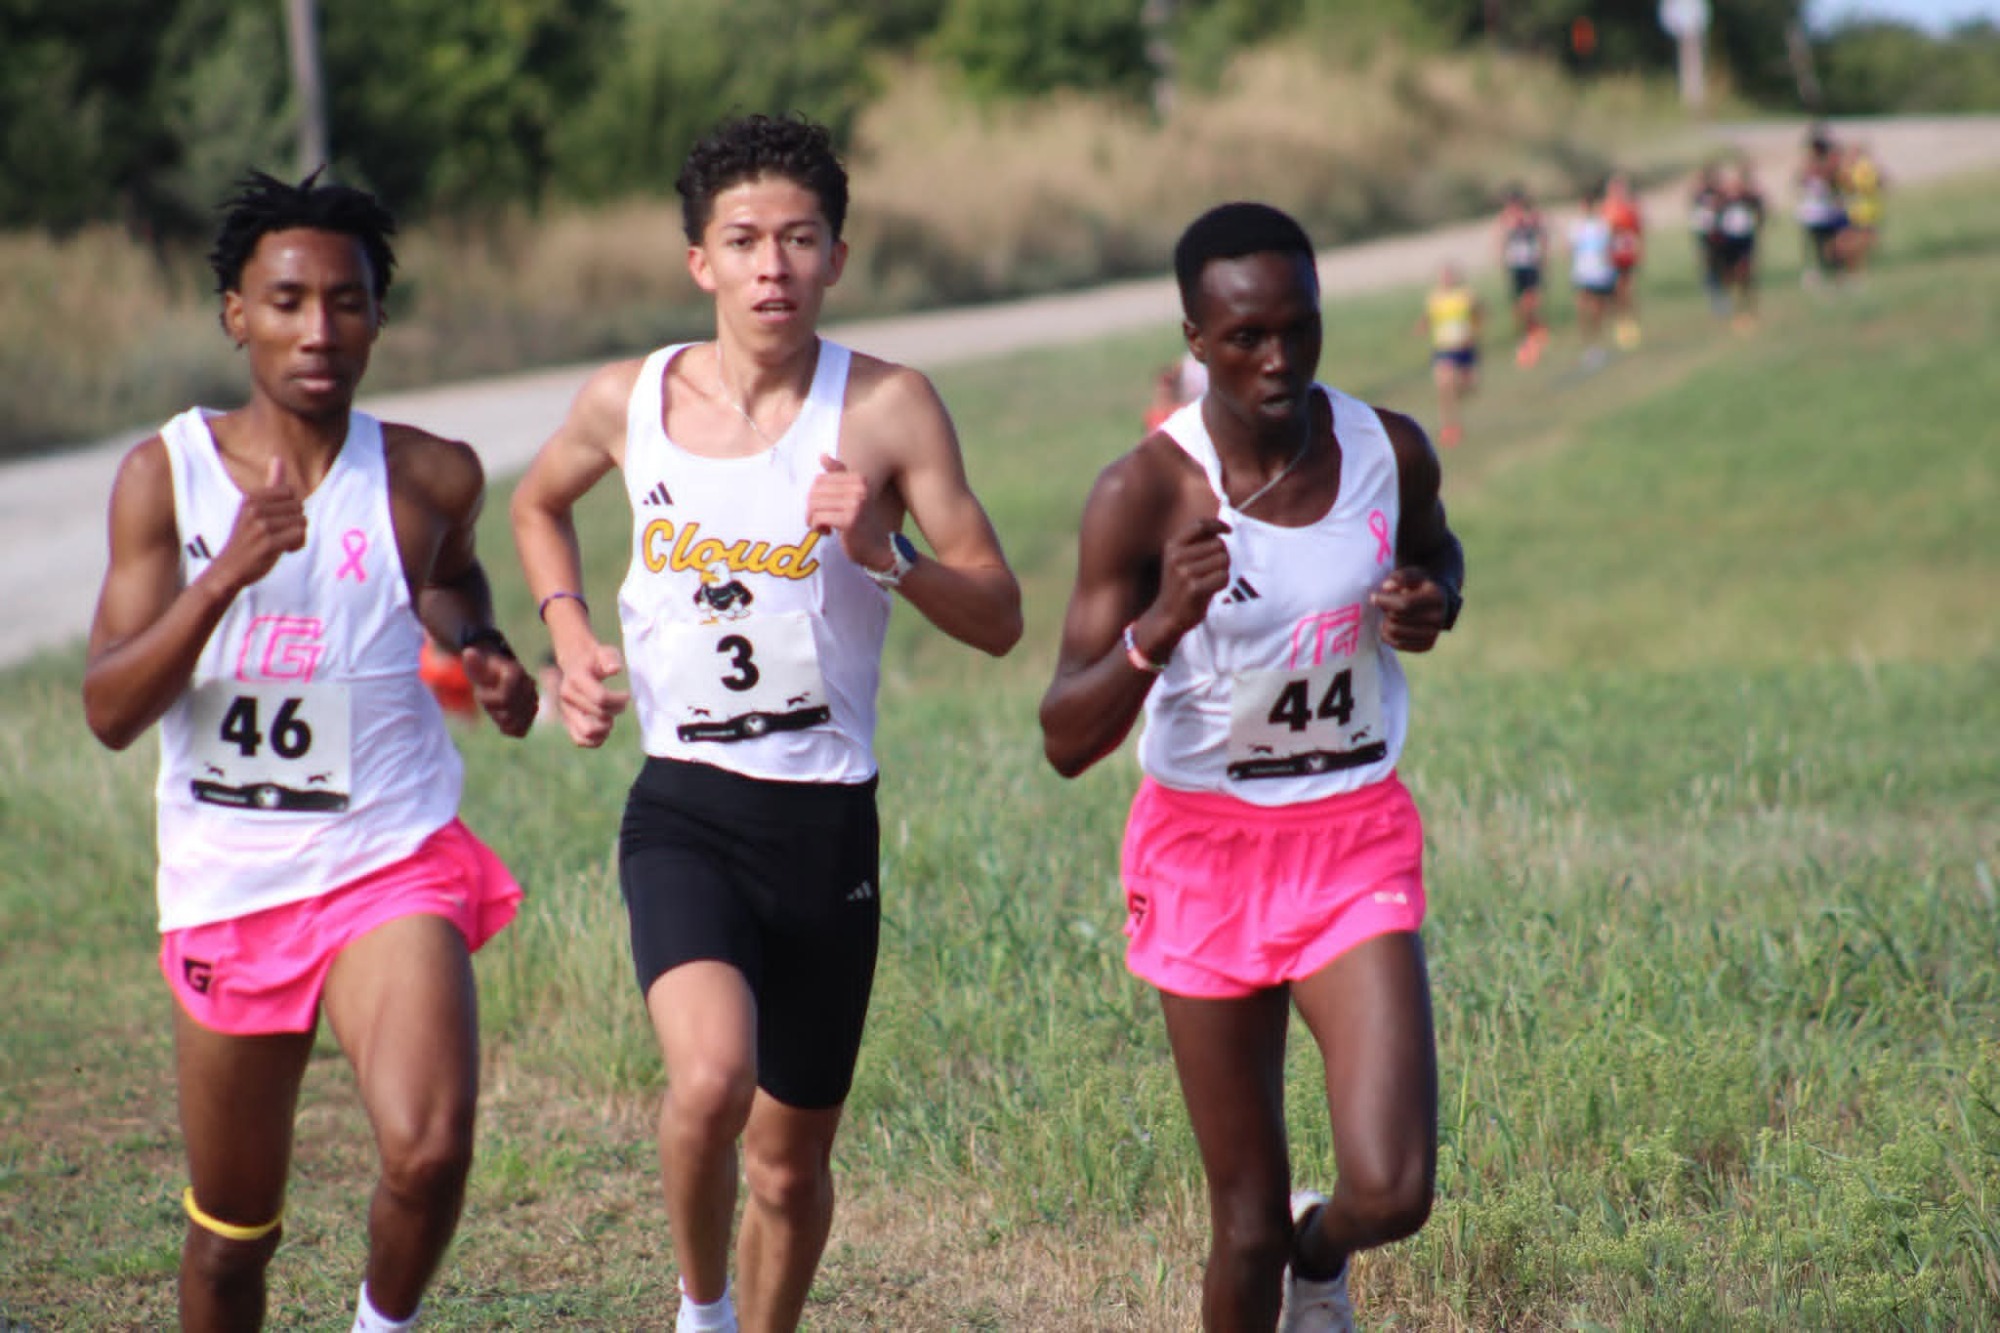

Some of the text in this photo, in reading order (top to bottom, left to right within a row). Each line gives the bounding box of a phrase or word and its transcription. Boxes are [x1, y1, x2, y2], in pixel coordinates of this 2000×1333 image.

[642, 518, 821, 580] Cloud
[236, 615, 325, 684] G
[716, 634, 760, 692] 3
[220, 695, 313, 761] 46
[1267, 667, 1355, 733] 44
